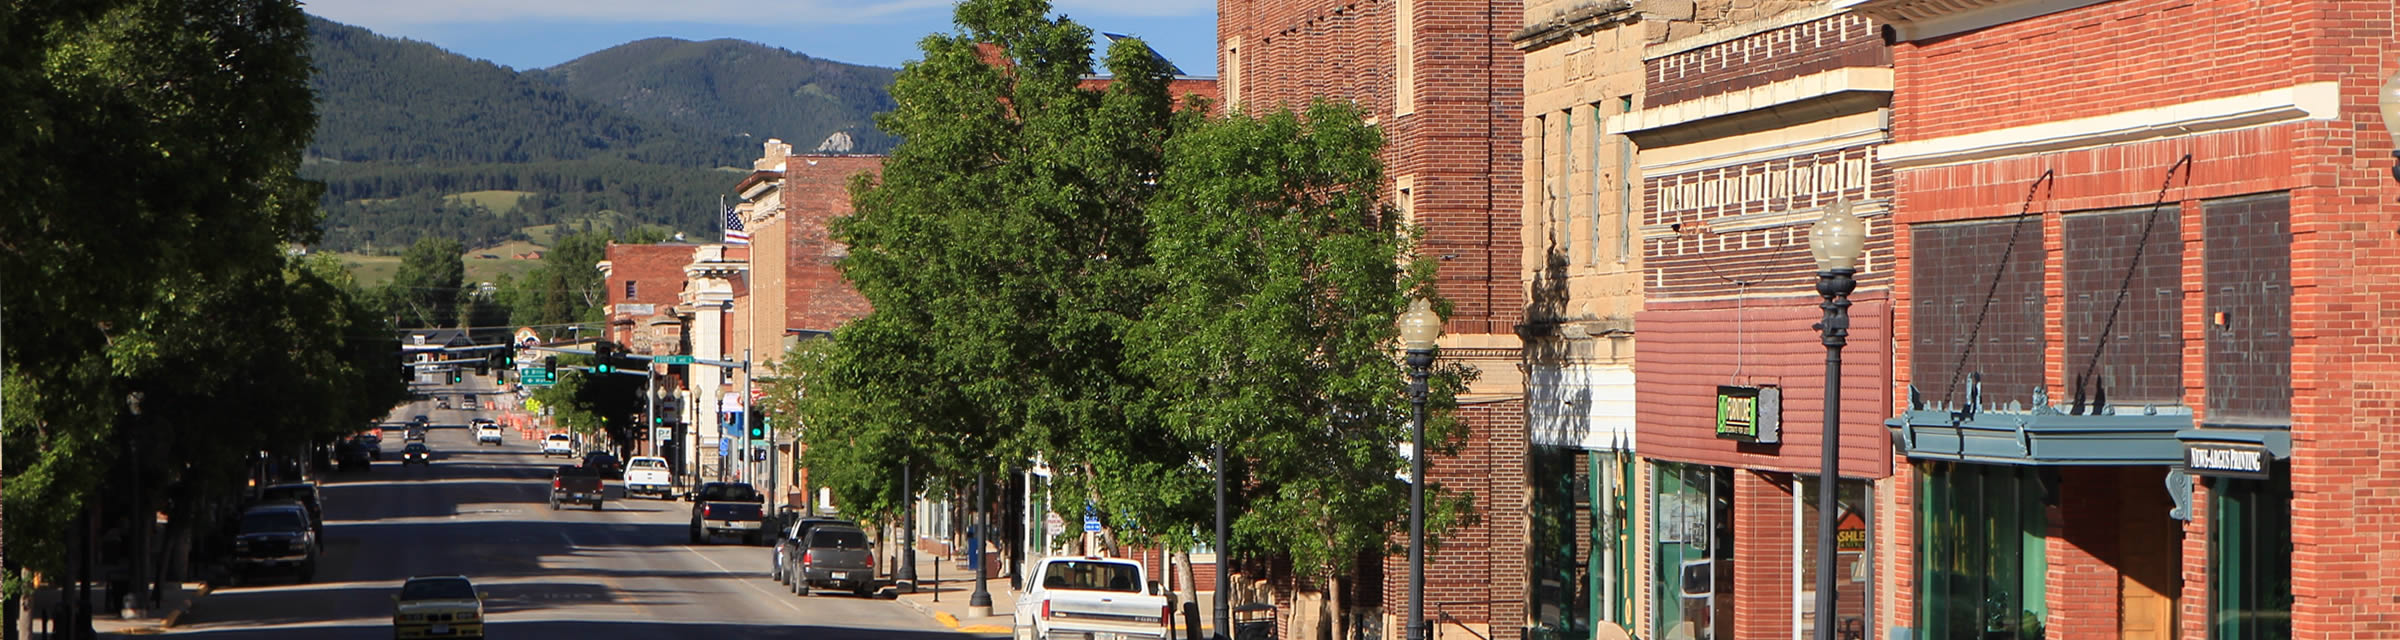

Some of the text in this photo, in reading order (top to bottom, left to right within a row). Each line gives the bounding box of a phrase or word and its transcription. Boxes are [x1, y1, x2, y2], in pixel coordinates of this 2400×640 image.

[2191, 448, 2261, 472] NEWS-ARGUS PRINTING
[1615, 450, 1634, 636] ANTIQ
